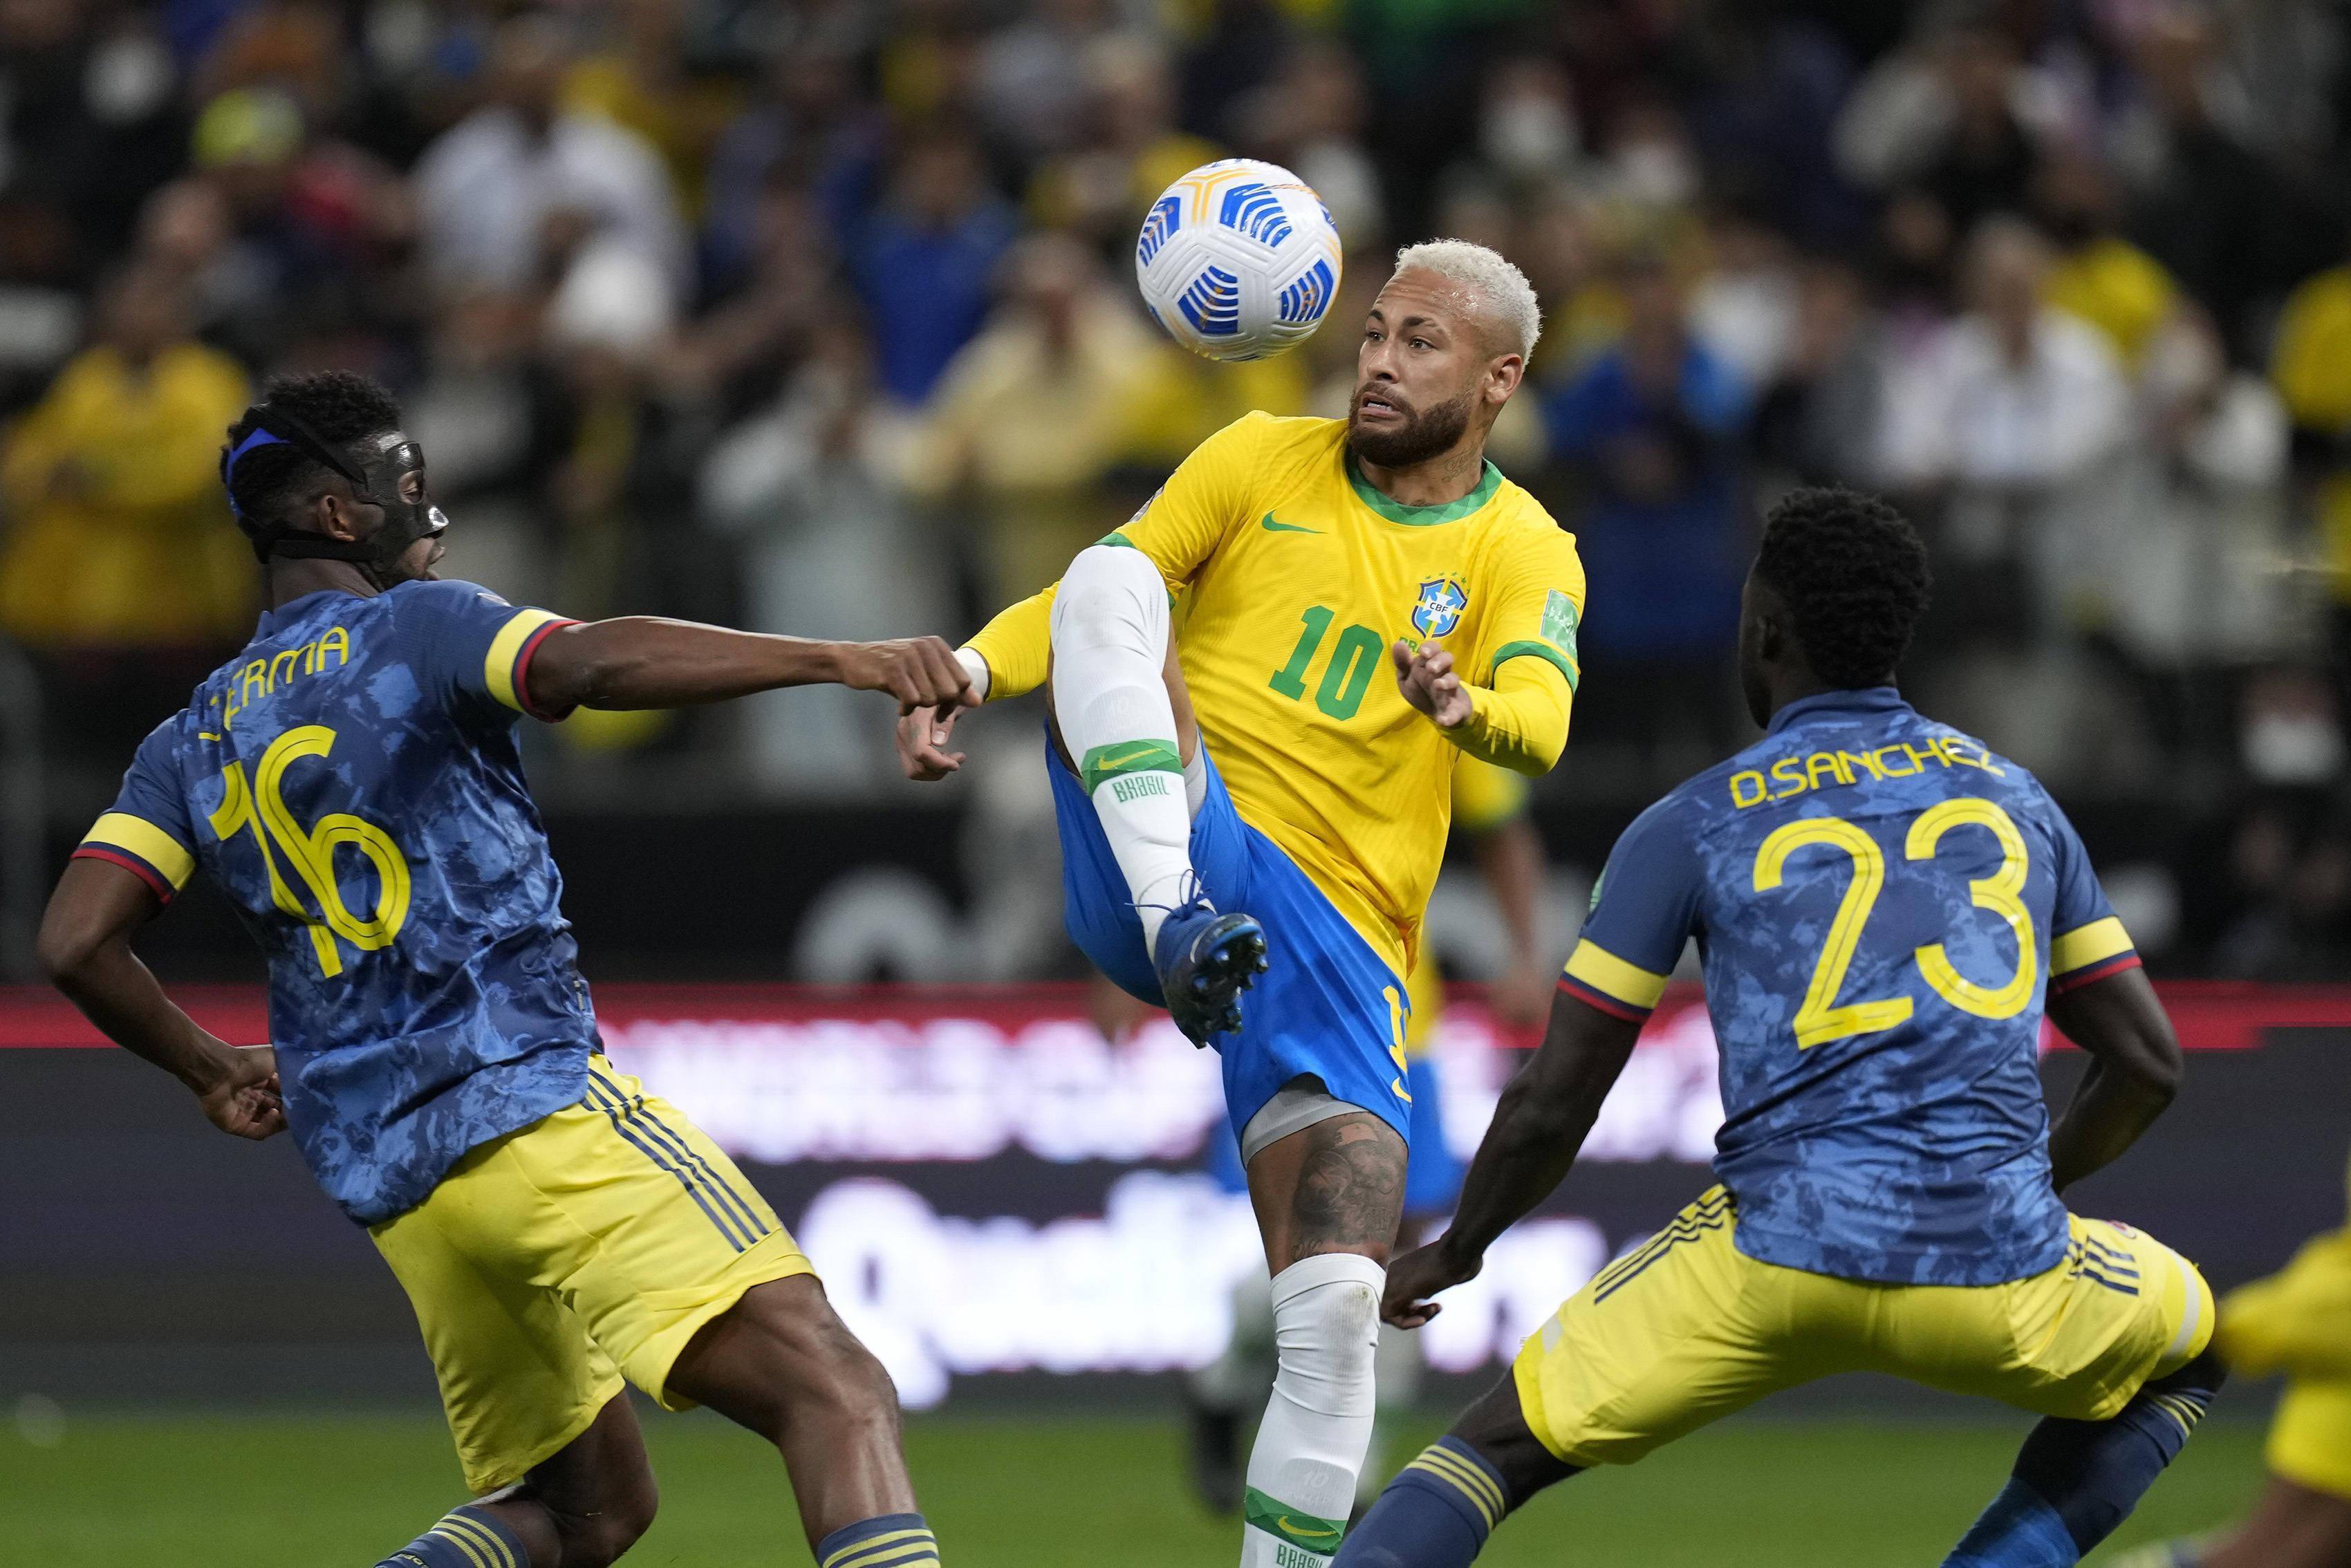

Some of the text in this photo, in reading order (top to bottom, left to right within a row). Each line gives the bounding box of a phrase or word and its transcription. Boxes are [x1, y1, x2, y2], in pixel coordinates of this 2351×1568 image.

[1429, 601, 1449, 613] CBF
[1268, 605, 1384, 721] 10
[1112, 775, 1171, 803] BRASIL
[1730, 736, 2005, 809] D.SANCHEZ
[209, 725, 411, 978] 16
[1753, 797, 2037, 1050] 23
